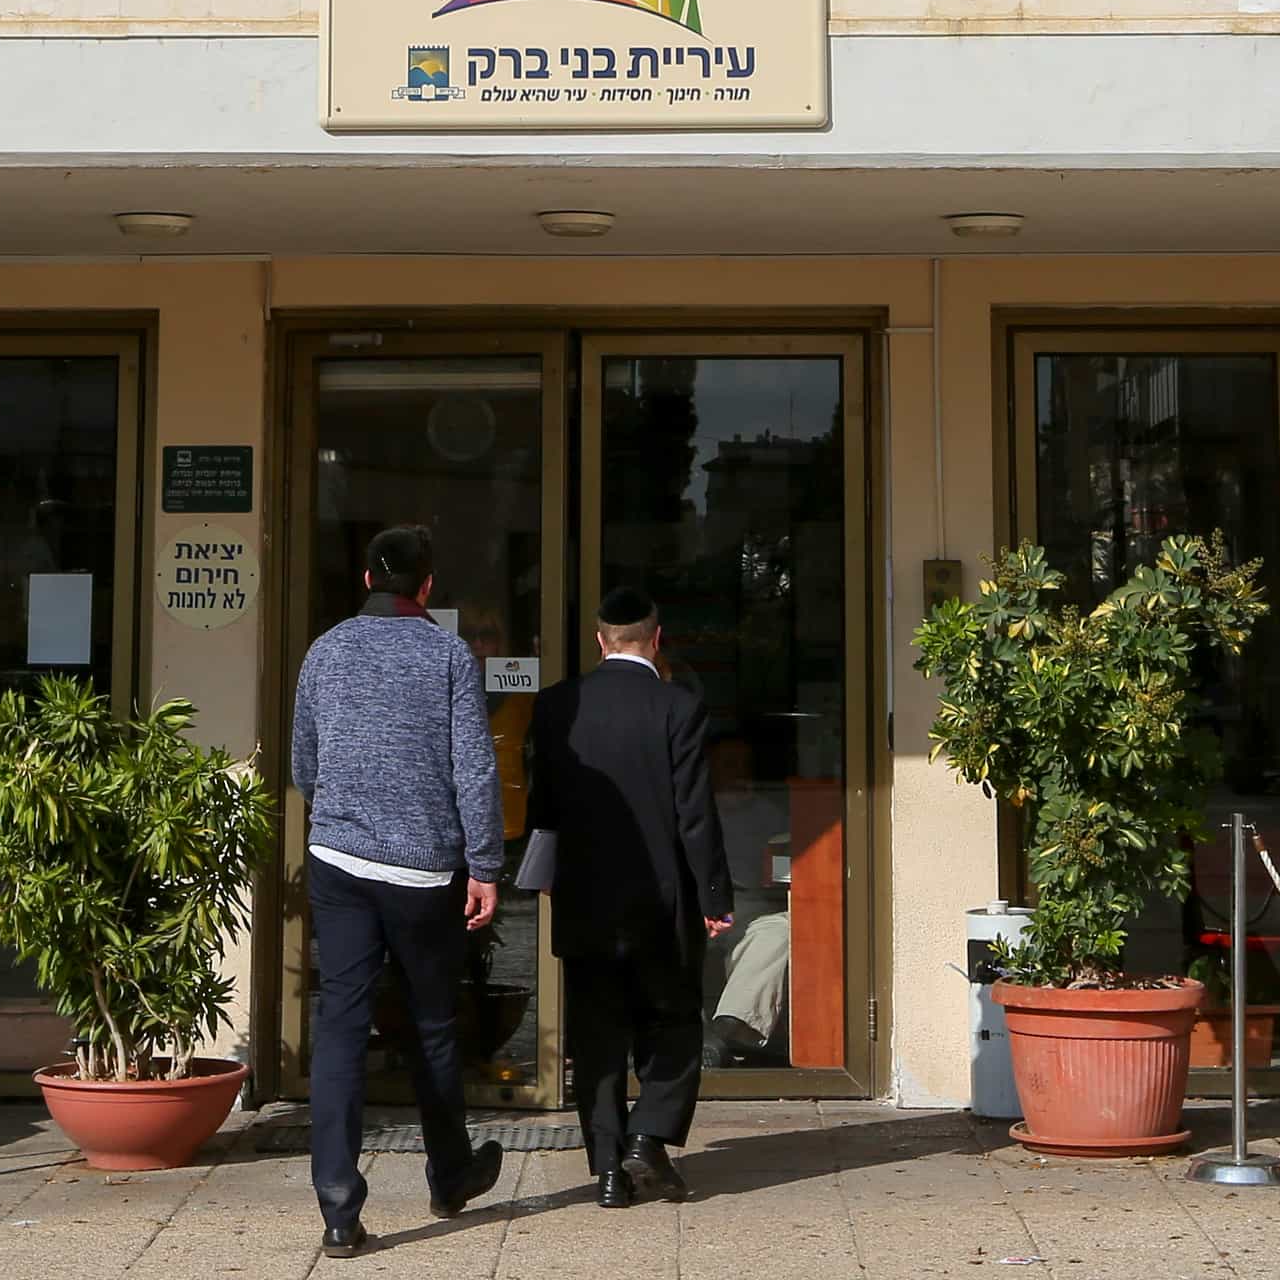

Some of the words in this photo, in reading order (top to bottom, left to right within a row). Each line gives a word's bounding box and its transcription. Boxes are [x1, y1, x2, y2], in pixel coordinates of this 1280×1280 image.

[467, 47, 550, 87] ברק
[560, 47, 617, 79] בני
[626, 47, 755, 79] עיריית
[480, 85, 517, 102] עולם
[519, 88, 561, 102] שהיא
[563, 88, 587, 101] עיר
[599, 88, 652, 102] חסידות
[665, 87, 702, 105] חינוך
[714, 87, 751, 101] תורה
[174, 542, 243, 560] יציאת
[175, 567, 239, 585] חירום
[167, 587, 217, 609] לחנות
[222, 588, 246, 609] לא
[493, 674, 532, 690] משוך
